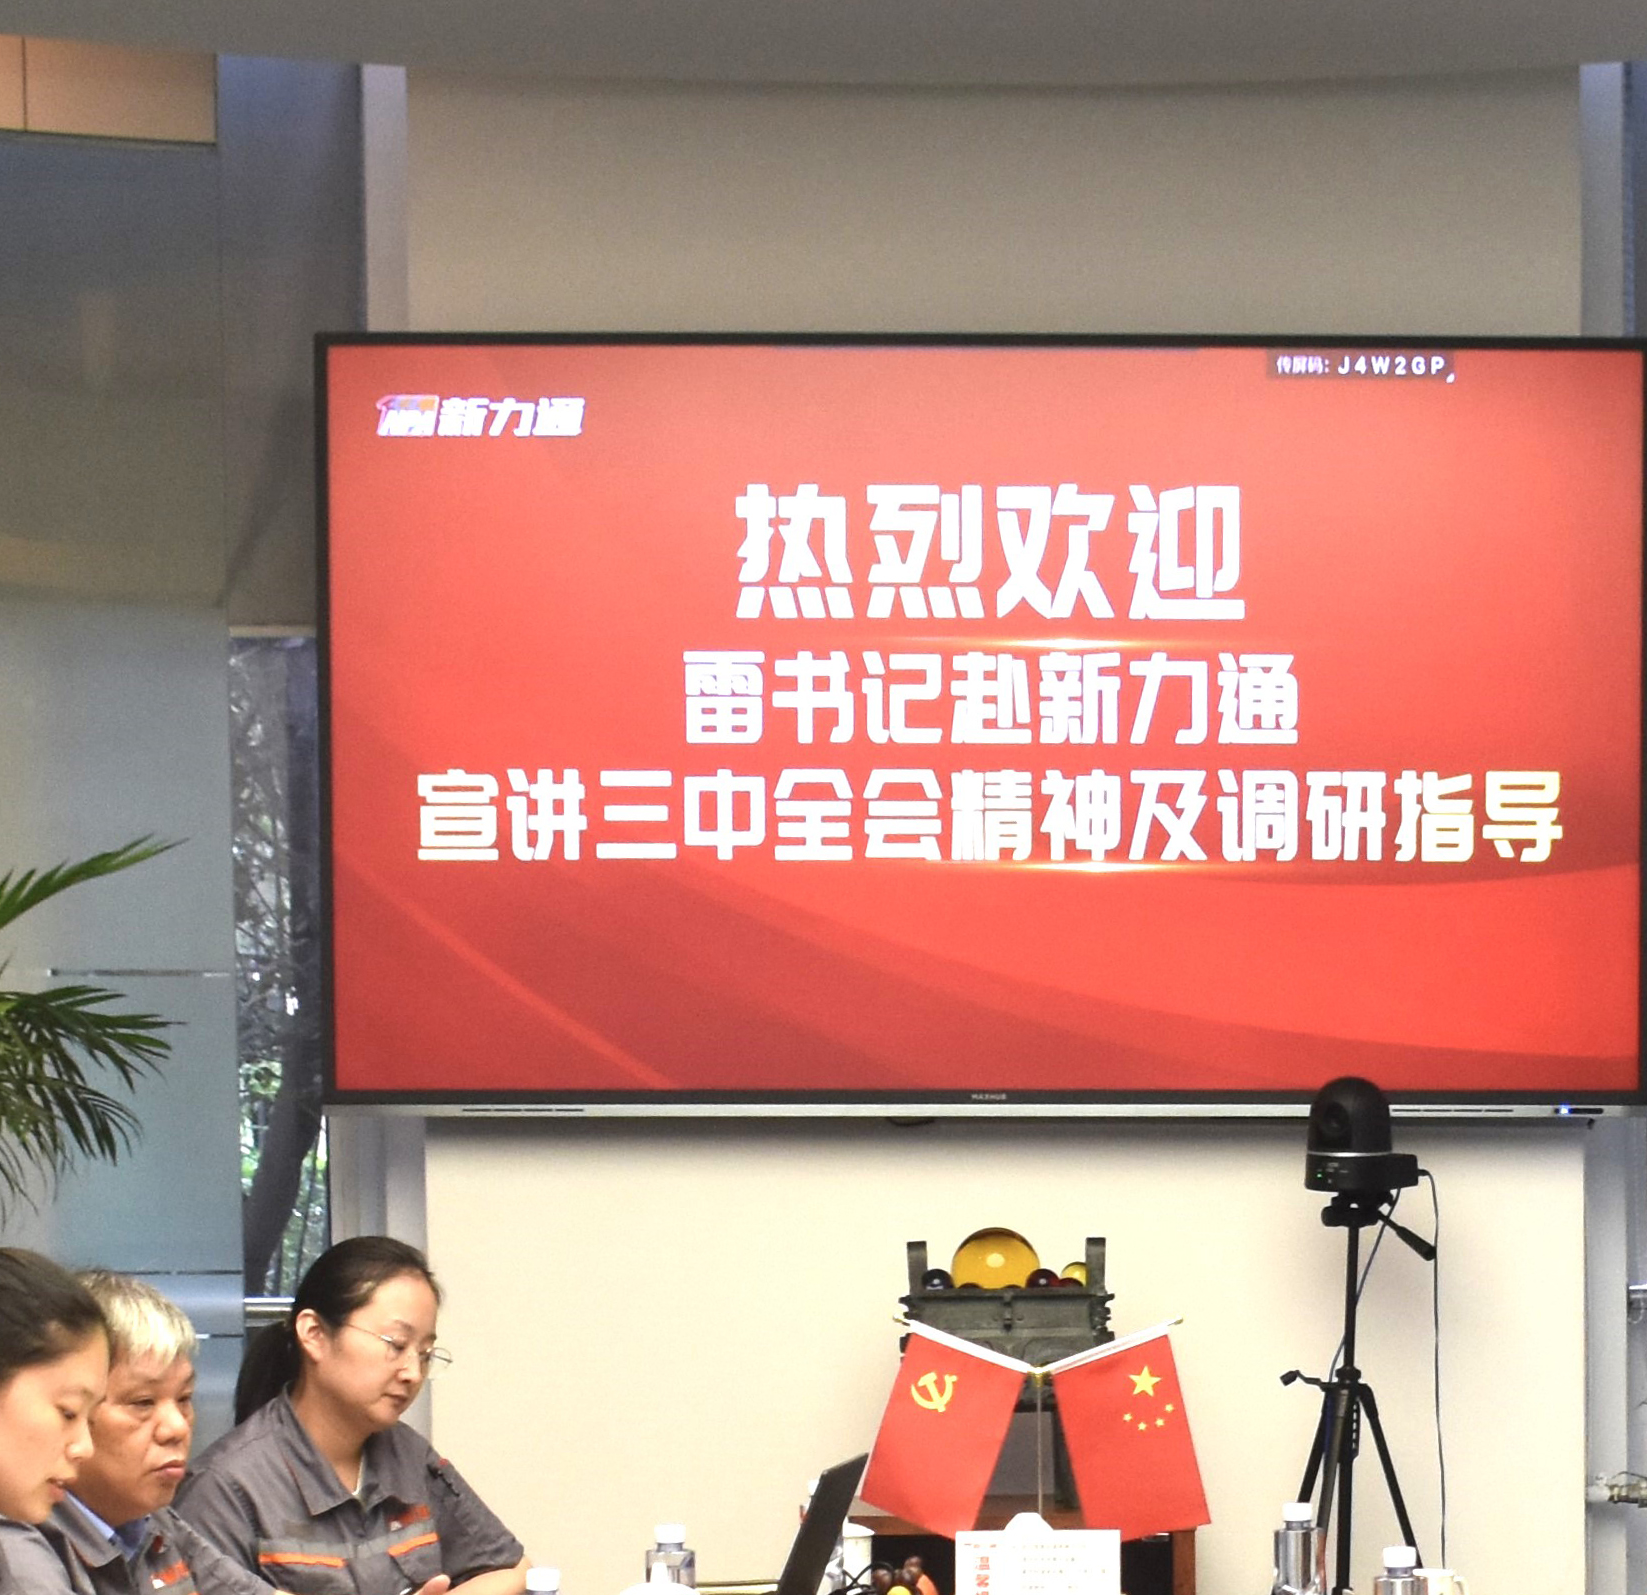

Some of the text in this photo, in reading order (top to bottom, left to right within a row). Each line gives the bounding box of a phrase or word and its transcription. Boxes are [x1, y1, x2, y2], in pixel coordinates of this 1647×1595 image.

[1338, 355, 1445, 375] J4W2GP
[735, 483, 1246, 620] 热烈欢迎
[683, 650, 1300, 746] 雷书记赴新力通
[416, 768, 1565, 864] 宣讲三中全会精神及调研指导
